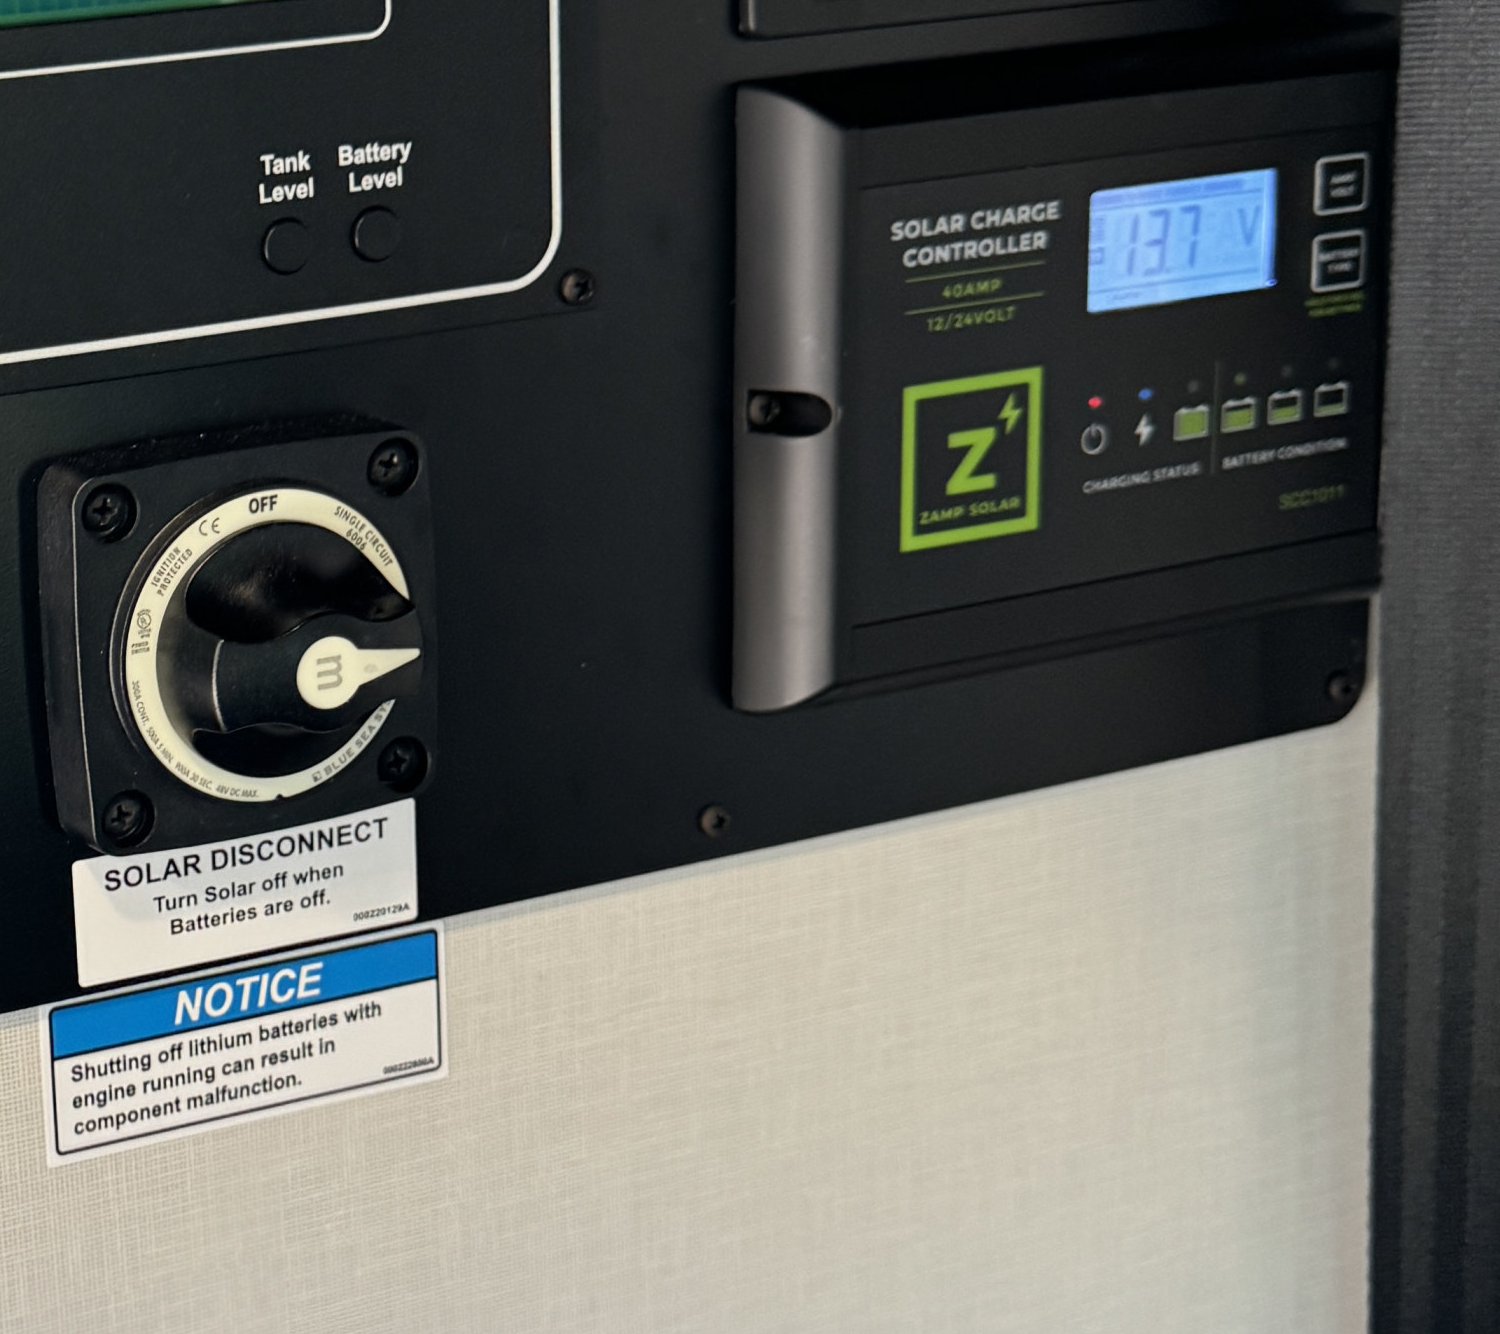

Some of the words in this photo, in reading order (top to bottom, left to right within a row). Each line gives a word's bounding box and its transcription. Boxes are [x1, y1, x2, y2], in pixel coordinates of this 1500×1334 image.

[259, 149, 311, 176] Tank
[338, 141, 413, 167] Battery
[258, 176, 315, 204] Level
[349, 164, 403, 193] Level
[890, 213, 966, 242] SOLAR
[970, 199, 1062, 230] CHARGE
[1238, 204, 1261, 246] V
[902, 230, 1050, 269] CONTROLLER
[941, 278, 1003, 299] 40AMP
[926, 305, 1017, 332] 12/24VOLT
[945, 427, 997, 496] Z
[1082, 470, 1151, 494] CHARGING
[1152, 461, 1201, 482] STATUS
[1222, 448, 1277, 469] BATTERY
[248, 494, 279, 515] OFF
[919, 504, 965, 525] ZAMP
[969, 495, 1021, 517] SOLAR
[334, 505, 367, 533] SINGLE
[364, 529, 394, 567] CIRCUIT
[345, 528, 368, 551] 6006
[151, 546, 181, 588] IGNITION
[156, 548, 194, 597] PROTECTED
[324, 746, 356, 776] BLUE
[355, 724, 377, 749] SEA
[104, 853, 202, 892] SOLAR
[210, 817, 389, 871] DISCONNECT
[153, 893, 198, 913] Turn
[205, 879, 256, 903] Solar
[261, 871, 288, 892] off
[292, 864, 344, 887] when
[170, 905, 258, 935] Batteries
[264, 900, 294, 917] are
[300, 888, 331, 910] off.
[174, 961, 324, 1025] NOTICE
[70, 1052, 151, 1083] Shutting
[157, 1042, 185, 1064] off
[188, 1030, 252, 1055] lithium
[258, 1011, 339, 1042] batteries
[343, 1000, 382, 1023] with
[72, 1081, 136, 1109] engine
[143, 1066, 216, 1095] running
[222, 1057, 256, 1077] can
[260, 1039, 314, 1068] result
[318, 1037, 336, 1055] in
[74, 1097, 182, 1135] component
[187, 1073, 303, 1109] malfunction.
